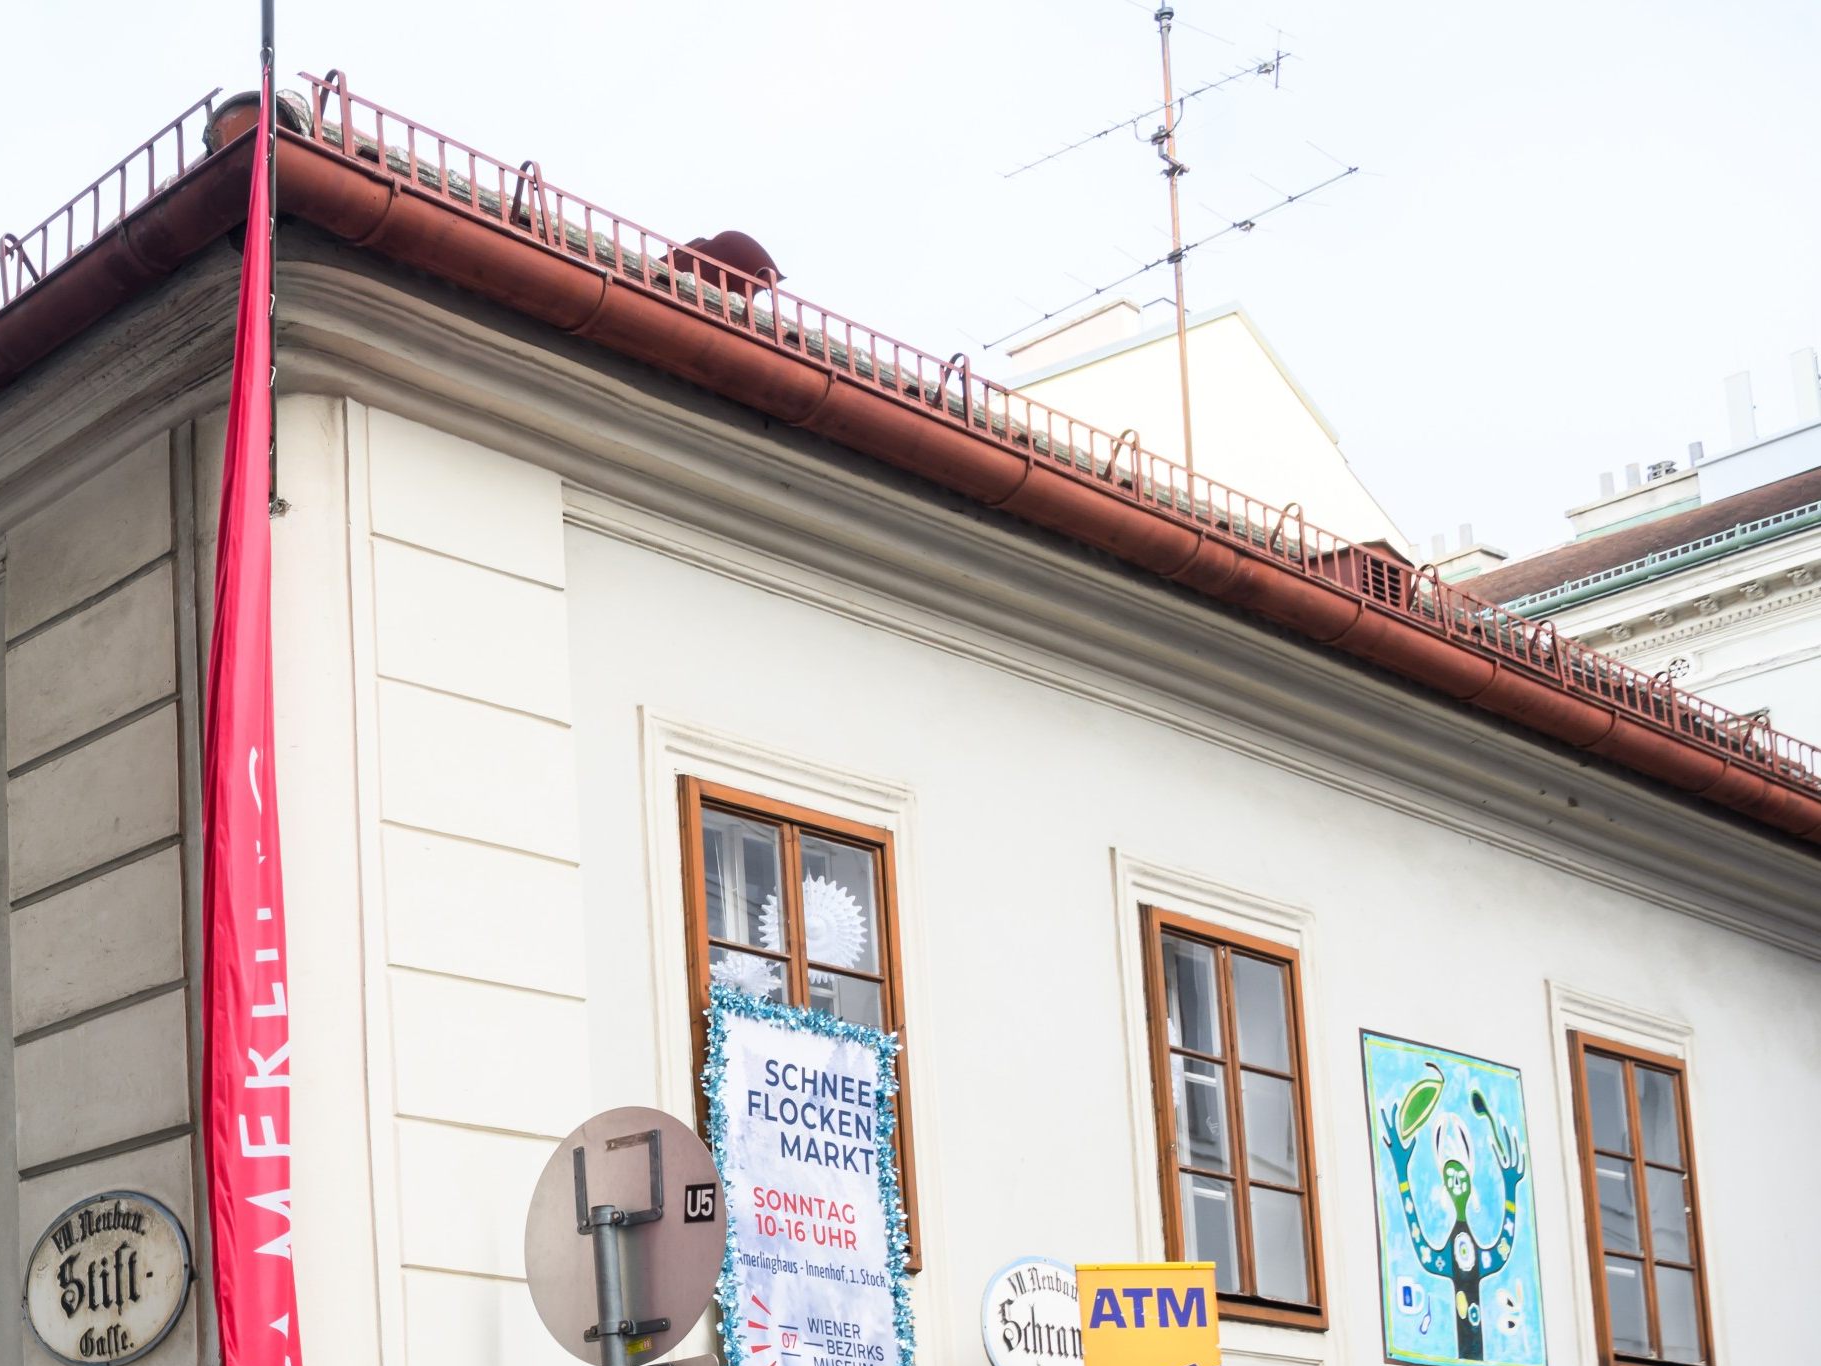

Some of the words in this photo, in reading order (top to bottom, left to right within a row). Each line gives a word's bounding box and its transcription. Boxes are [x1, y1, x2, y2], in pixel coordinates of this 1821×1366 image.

[764, 1059, 872, 1109] SCHNEE
[747, 1089, 872, 1142] FLOCKEN
[780, 1131, 875, 1176] MARKT
[685, 1187, 715, 1219] U5
[753, 1186, 856, 1226] SONNTAG
[755, 1213, 807, 1243] 10-16
[812, 1222, 858, 1252] UHR
[805, 1259, 849, 1284] Innenhof,
[850, 1269, 860, 1284] 1.
[861, 1268, 887, 1288] Stock
[1088, 1287, 1208, 1329] ATM
[781, 1332, 798, 1349] 07
[807, 1316, 861, 1340] WIENER
[997, 1298, 1084, 1360] Schran
[826, 1339, 885, 1362] BEZIRKS
